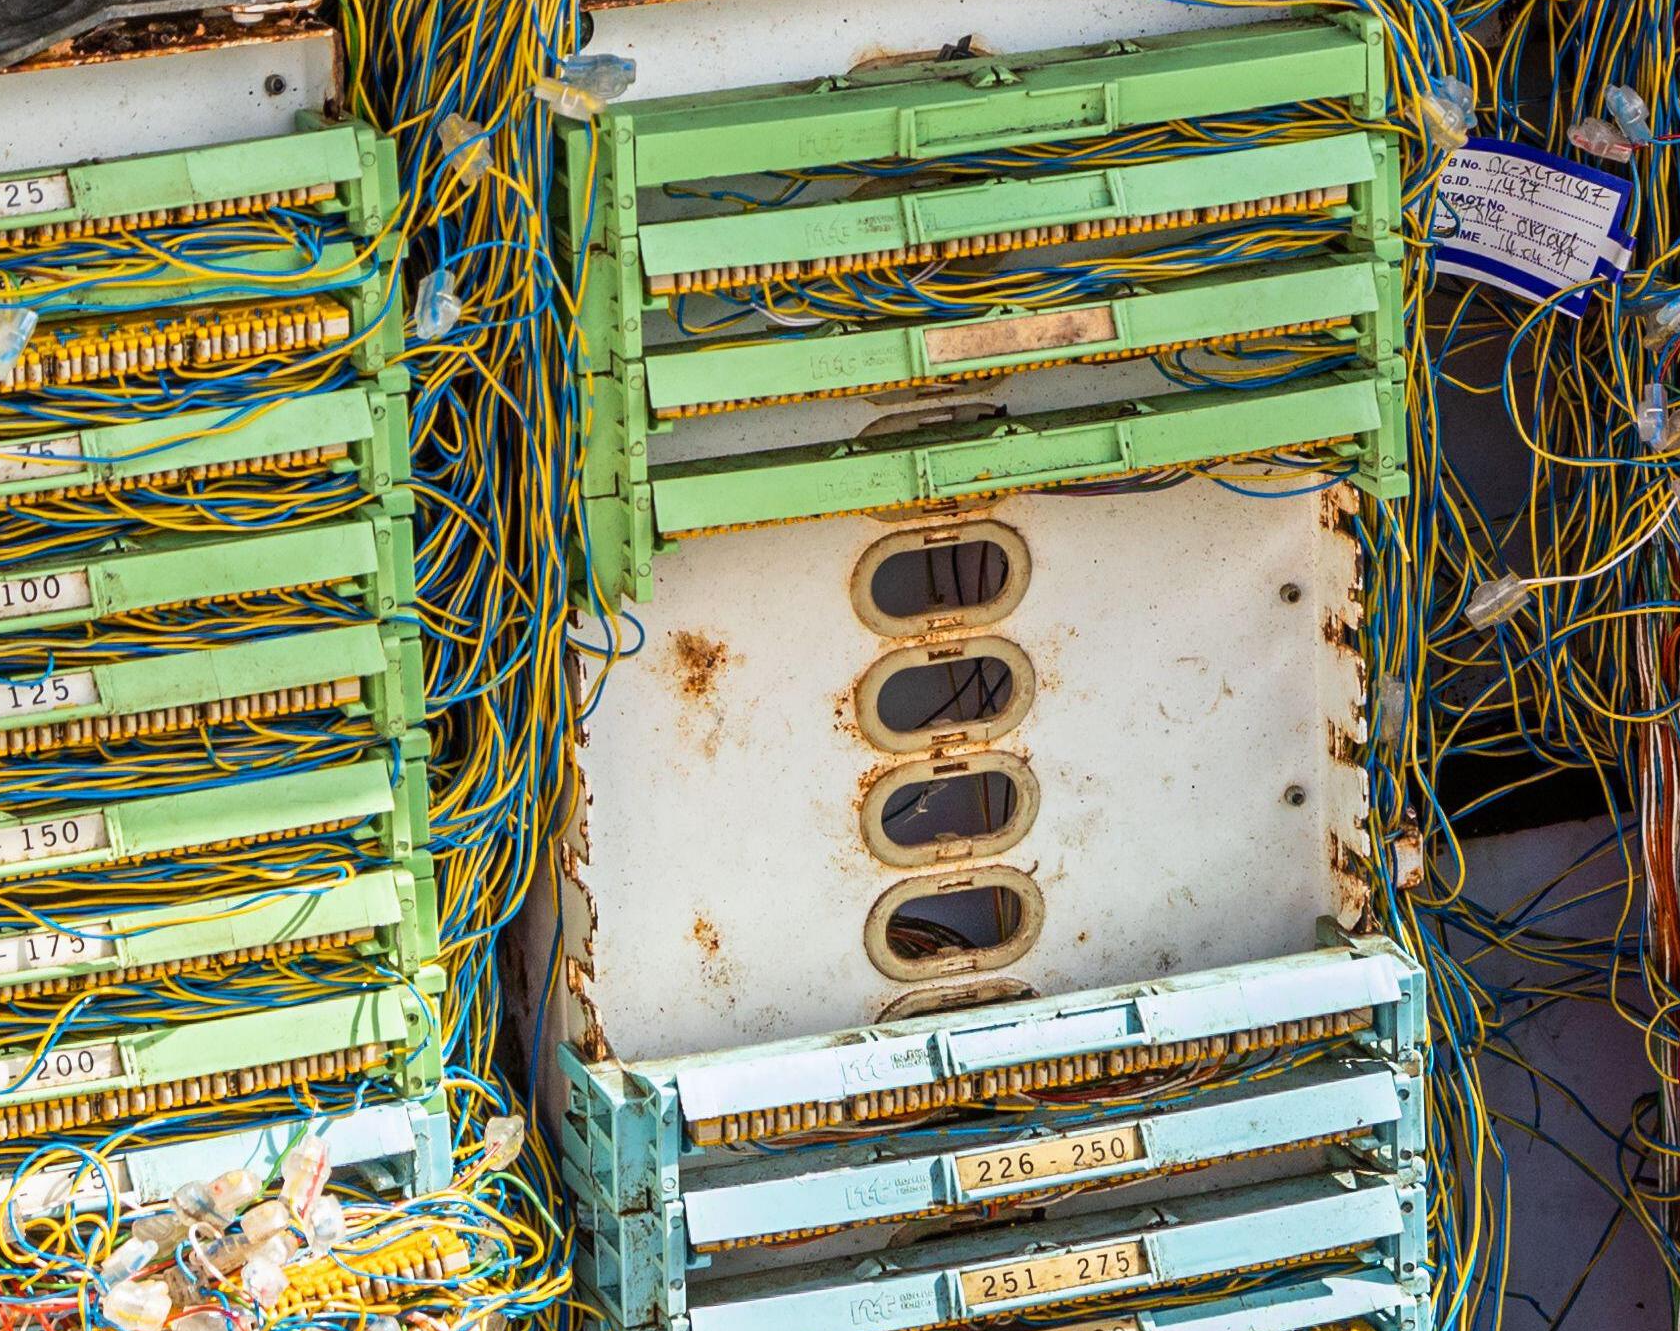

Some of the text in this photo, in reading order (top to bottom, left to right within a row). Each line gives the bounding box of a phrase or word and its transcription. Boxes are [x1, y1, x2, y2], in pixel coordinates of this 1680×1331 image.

[1460, 158, 1482, 172] No.
[5, 180, 44, 208] 25
[1, 575, 60, 607] 100
[8, 678, 69, 709] 125
[21, 820, 79, 851] 150
[26, 934, 85, 961] 175
[36, 1050, 95, 1081] 200
[978, 1152, 1035, 1184] 226
[1072, 1137, 1125, 1166] 250
[983, 1268, 1036, 1297] 251
[1078, 1251, 1131, 1280] 275
